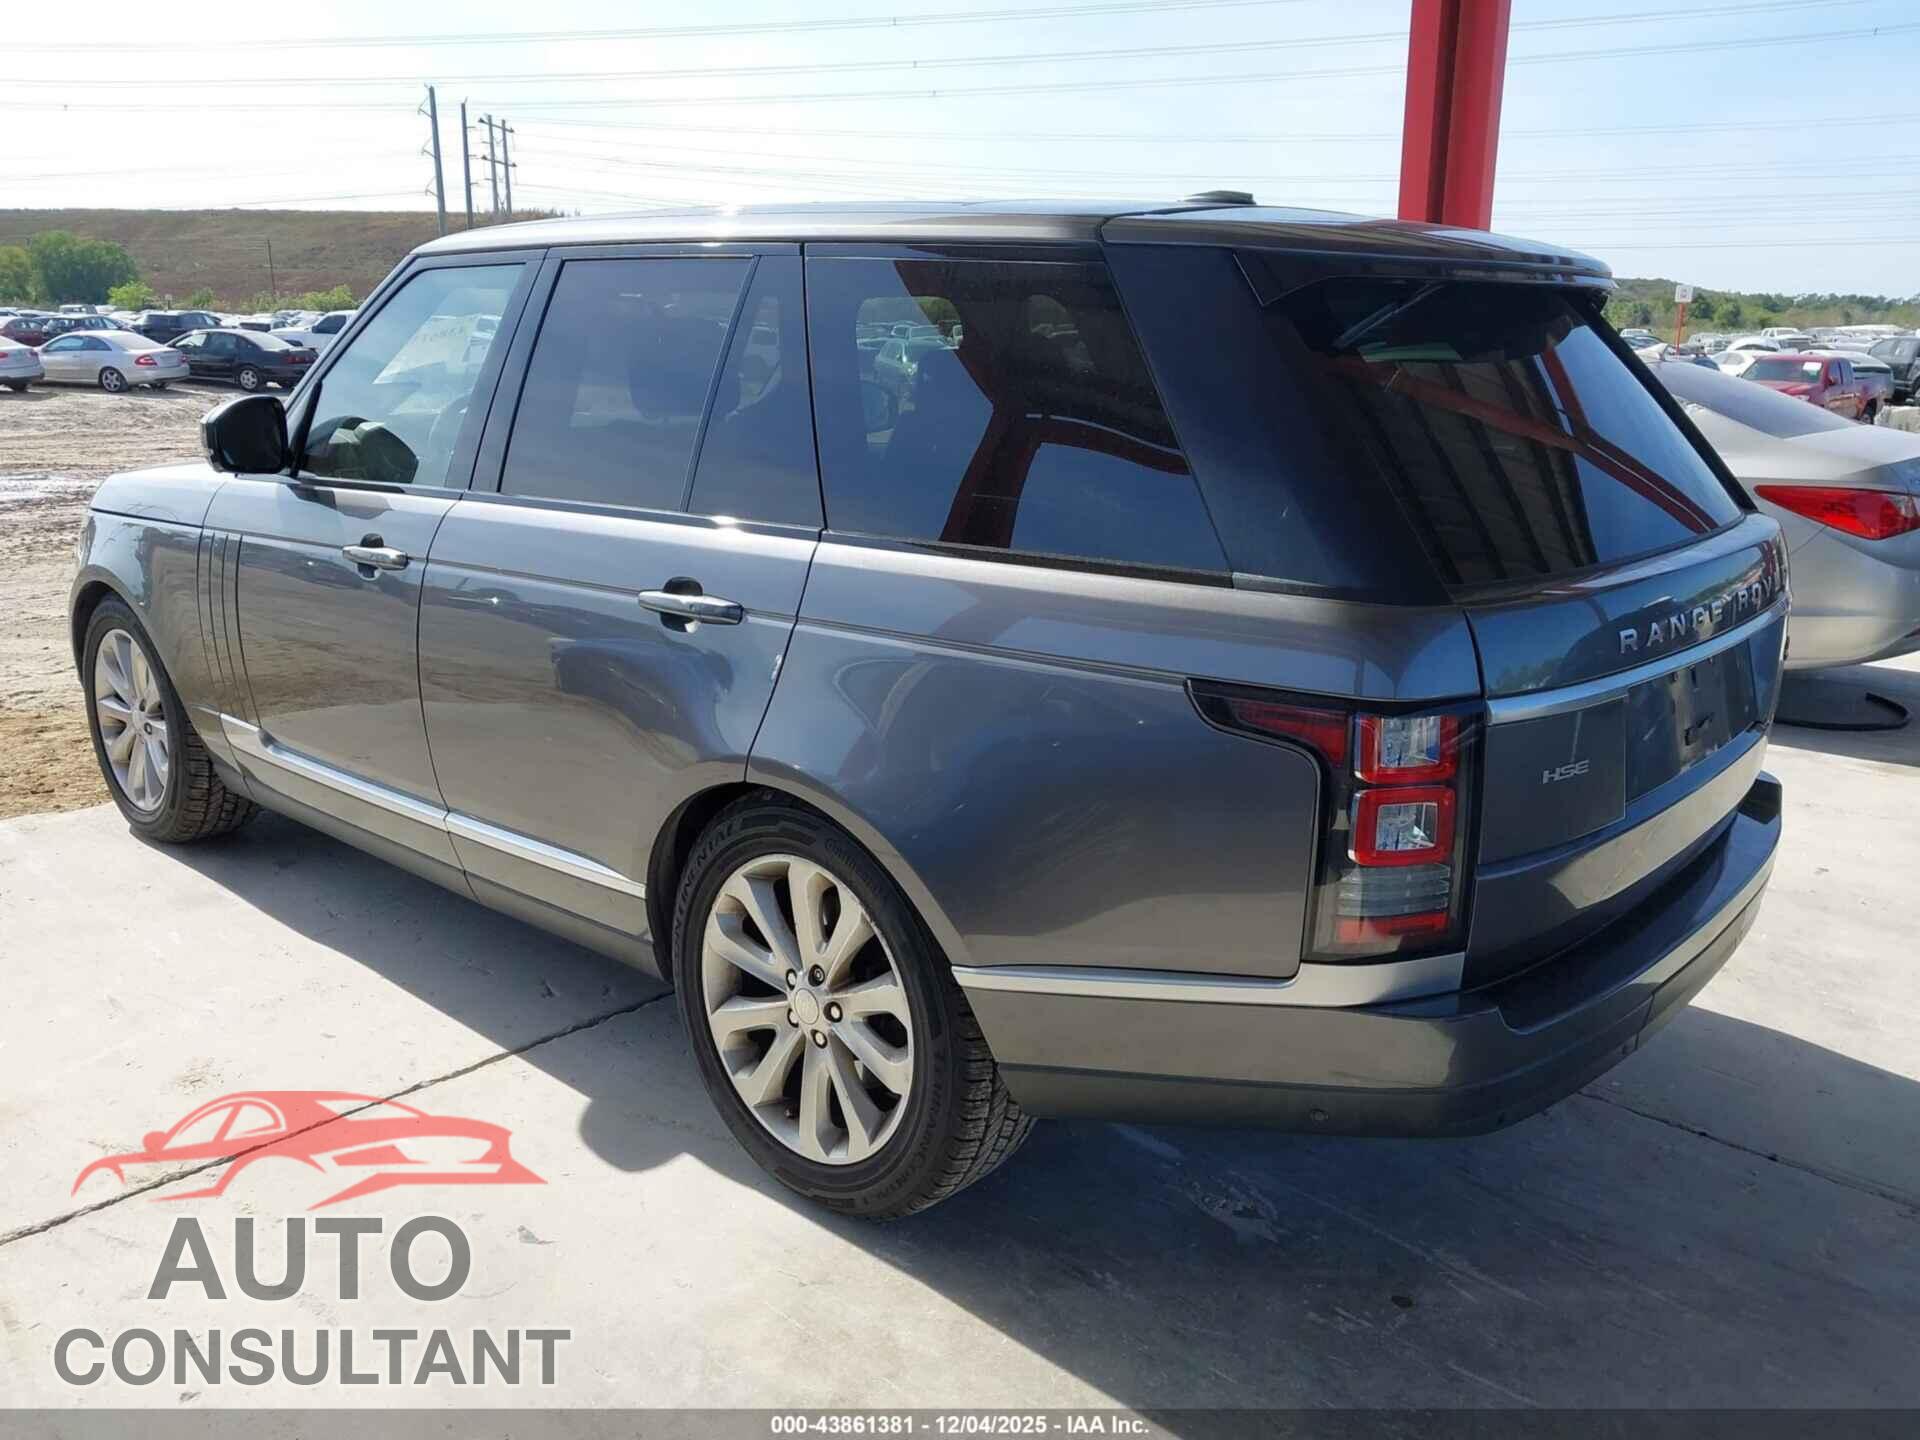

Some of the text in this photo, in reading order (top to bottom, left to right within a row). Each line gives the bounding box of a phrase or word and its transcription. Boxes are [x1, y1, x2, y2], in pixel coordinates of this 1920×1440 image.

[1619, 569, 1782, 655] RANGE ROV
[1542, 759, 1590, 785] HSE
